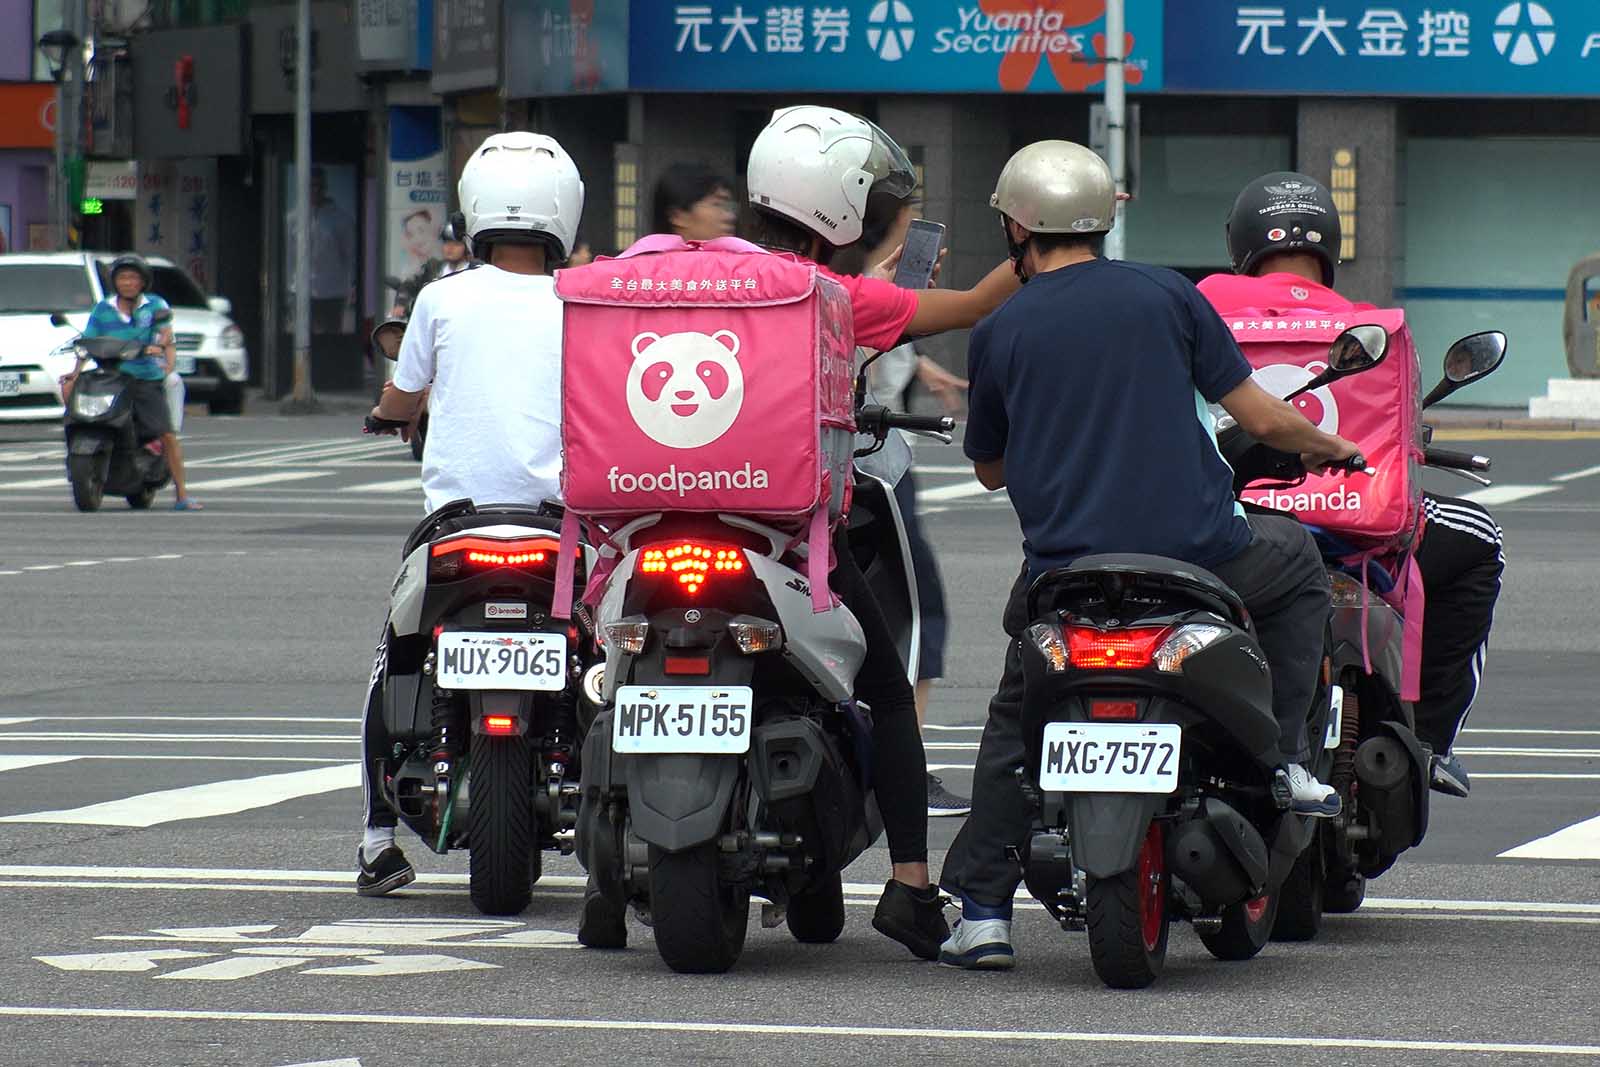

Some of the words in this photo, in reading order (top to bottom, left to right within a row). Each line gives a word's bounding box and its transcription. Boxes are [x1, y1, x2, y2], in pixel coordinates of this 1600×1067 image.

[674, 6, 850, 53] 元大證券
[957, 7, 1065, 31] Yuanta
[1236, 7, 1471, 57] 元大金控
[931, 28, 1085, 54] Securities
[812, 209, 839, 231] YAMAHA
[610, 276, 758, 292] 全台最大美食外送平台
[1229, 319, 1347, 331] 最大美食外送平台
[607, 462, 769, 497] foodpanda
[1242, 484, 1361, 513] dpanda
